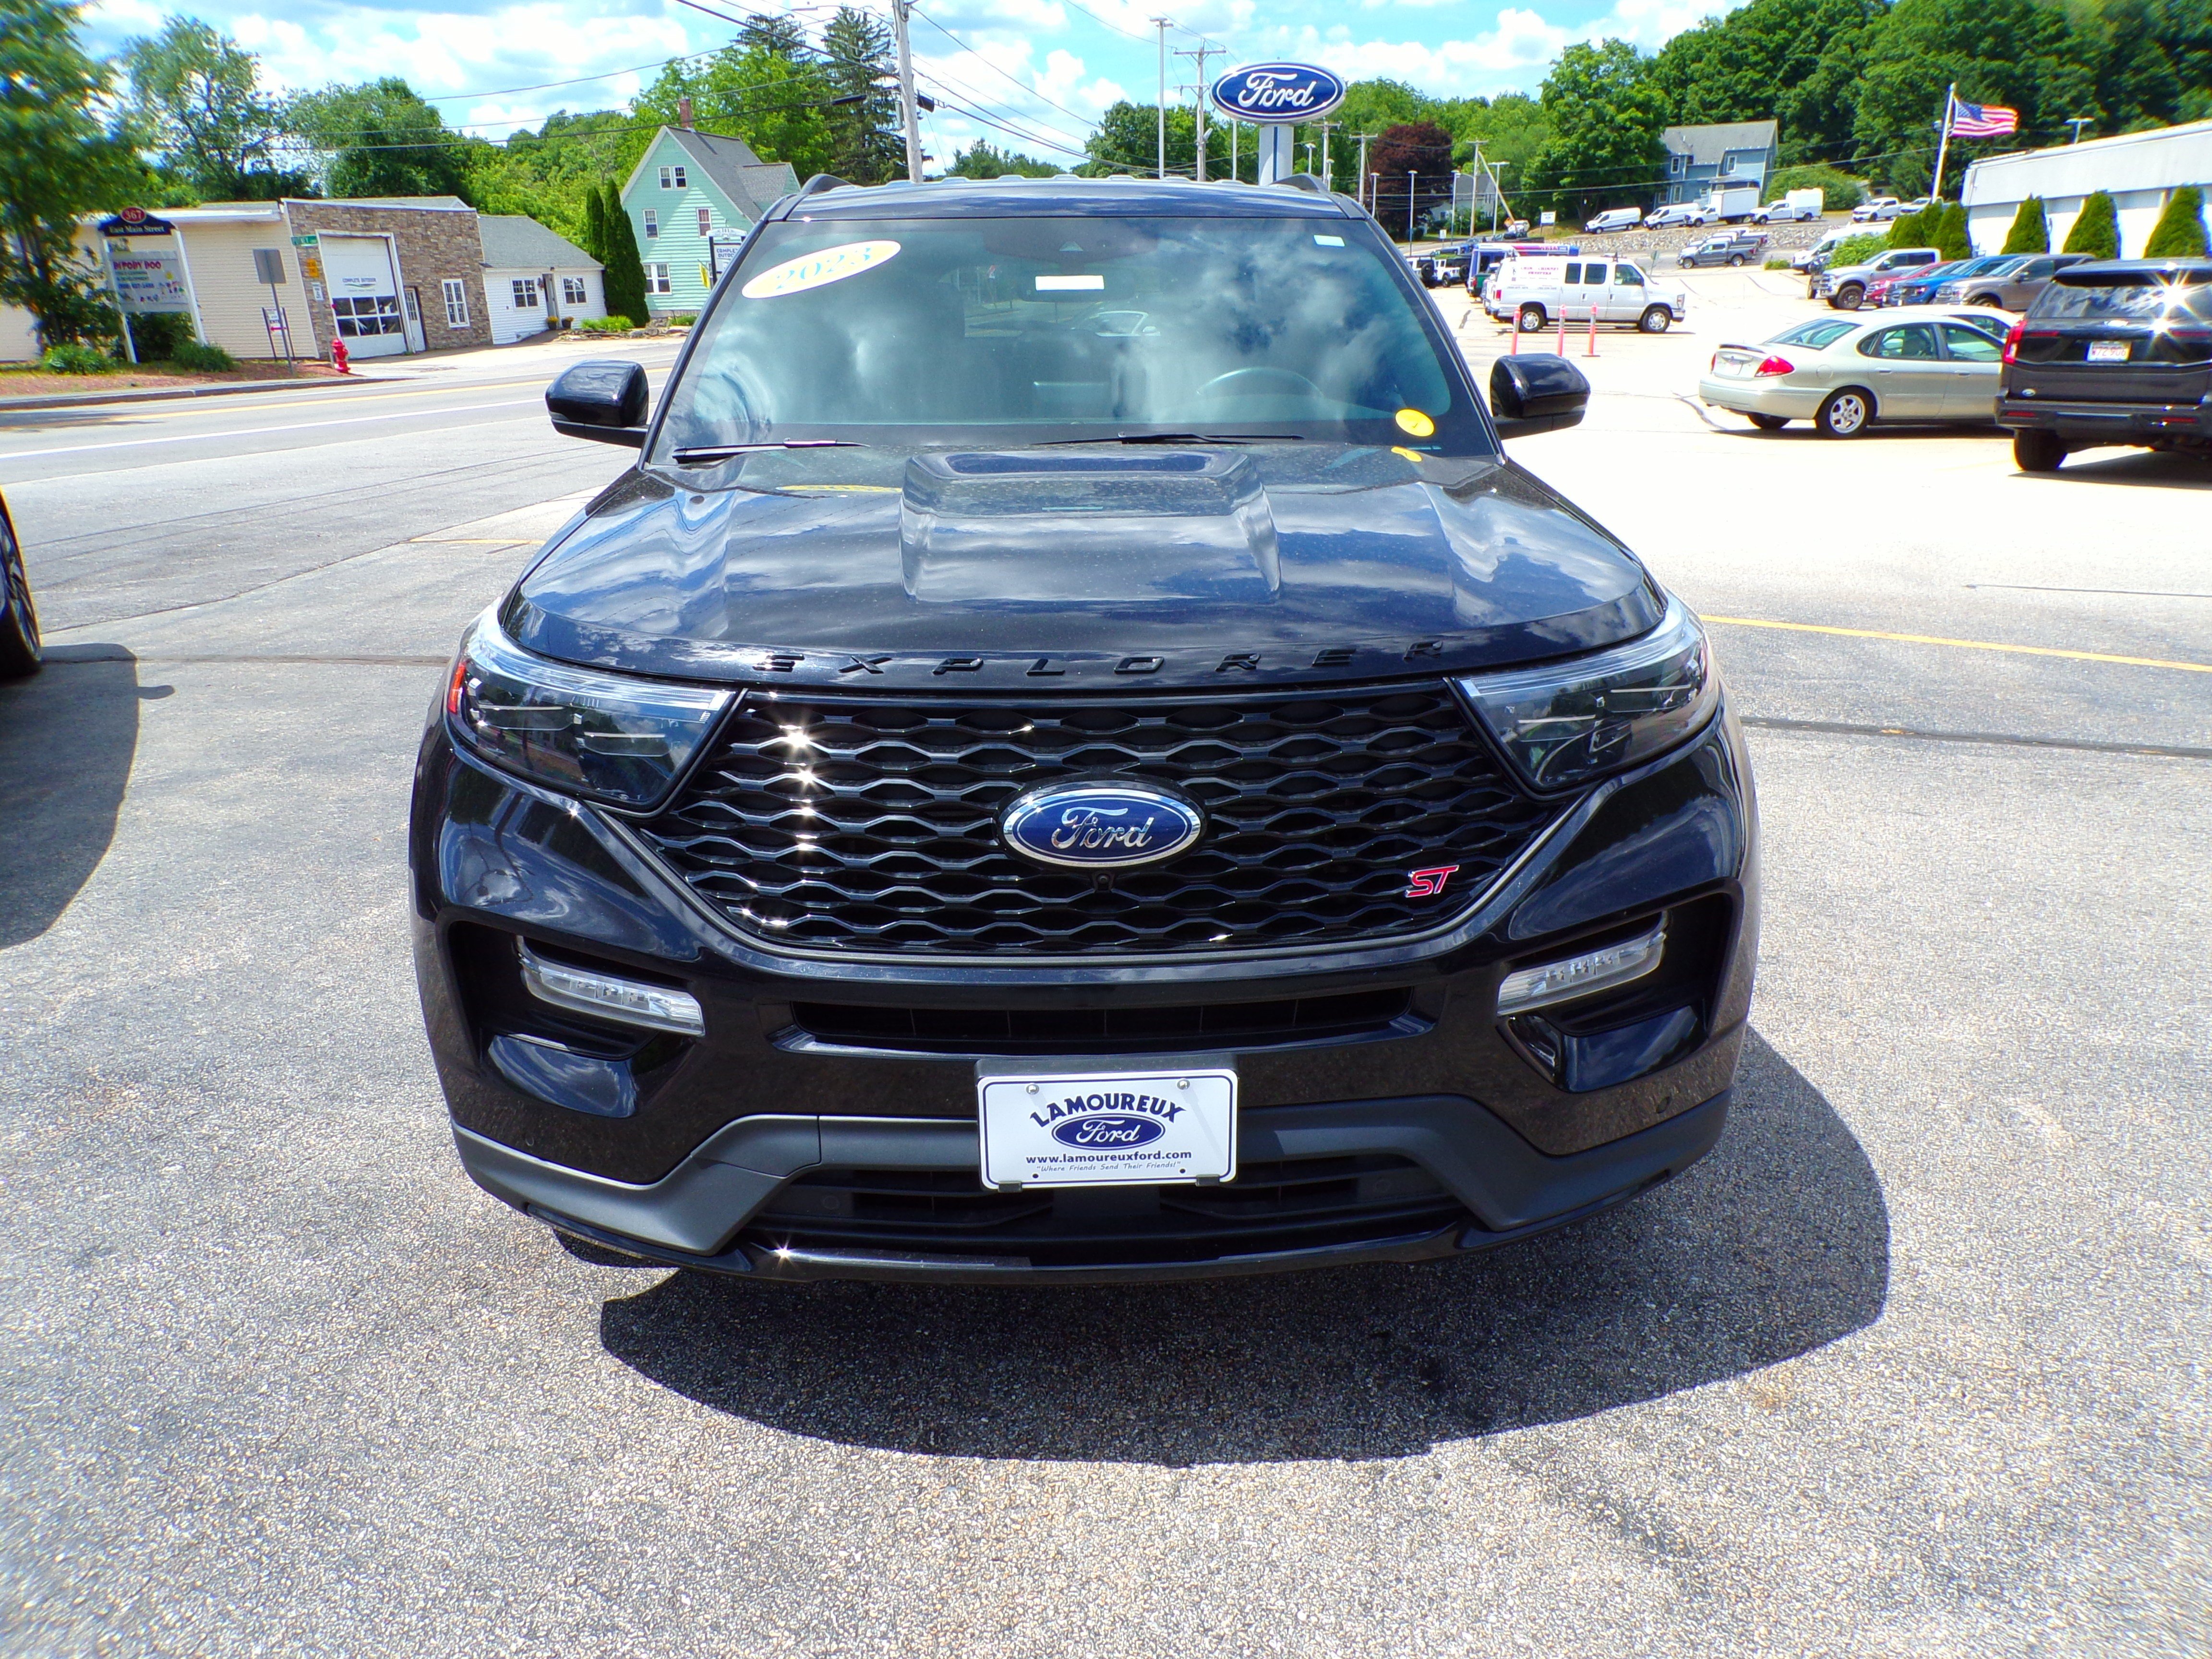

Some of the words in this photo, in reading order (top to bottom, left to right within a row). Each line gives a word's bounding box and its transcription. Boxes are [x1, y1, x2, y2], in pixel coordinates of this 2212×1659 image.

[1238, 72, 1317, 108] Ford
[125, 225, 144, 233] Main
[144, 225, 165, 233] Street
[776, 247, 872, 290] 2023
[752, 640, 1443, 676] EXPLORER
[1050, 806, 1155, 849] Ford
[1405, 864, 1460, 898] ST
[1029, 1093, 1187, 1128] LAMOUREUX
[1075, 1119, 1142, 1143] Ford
[1025, 1150, 1192, 1164] www.lamoureuxford.com
